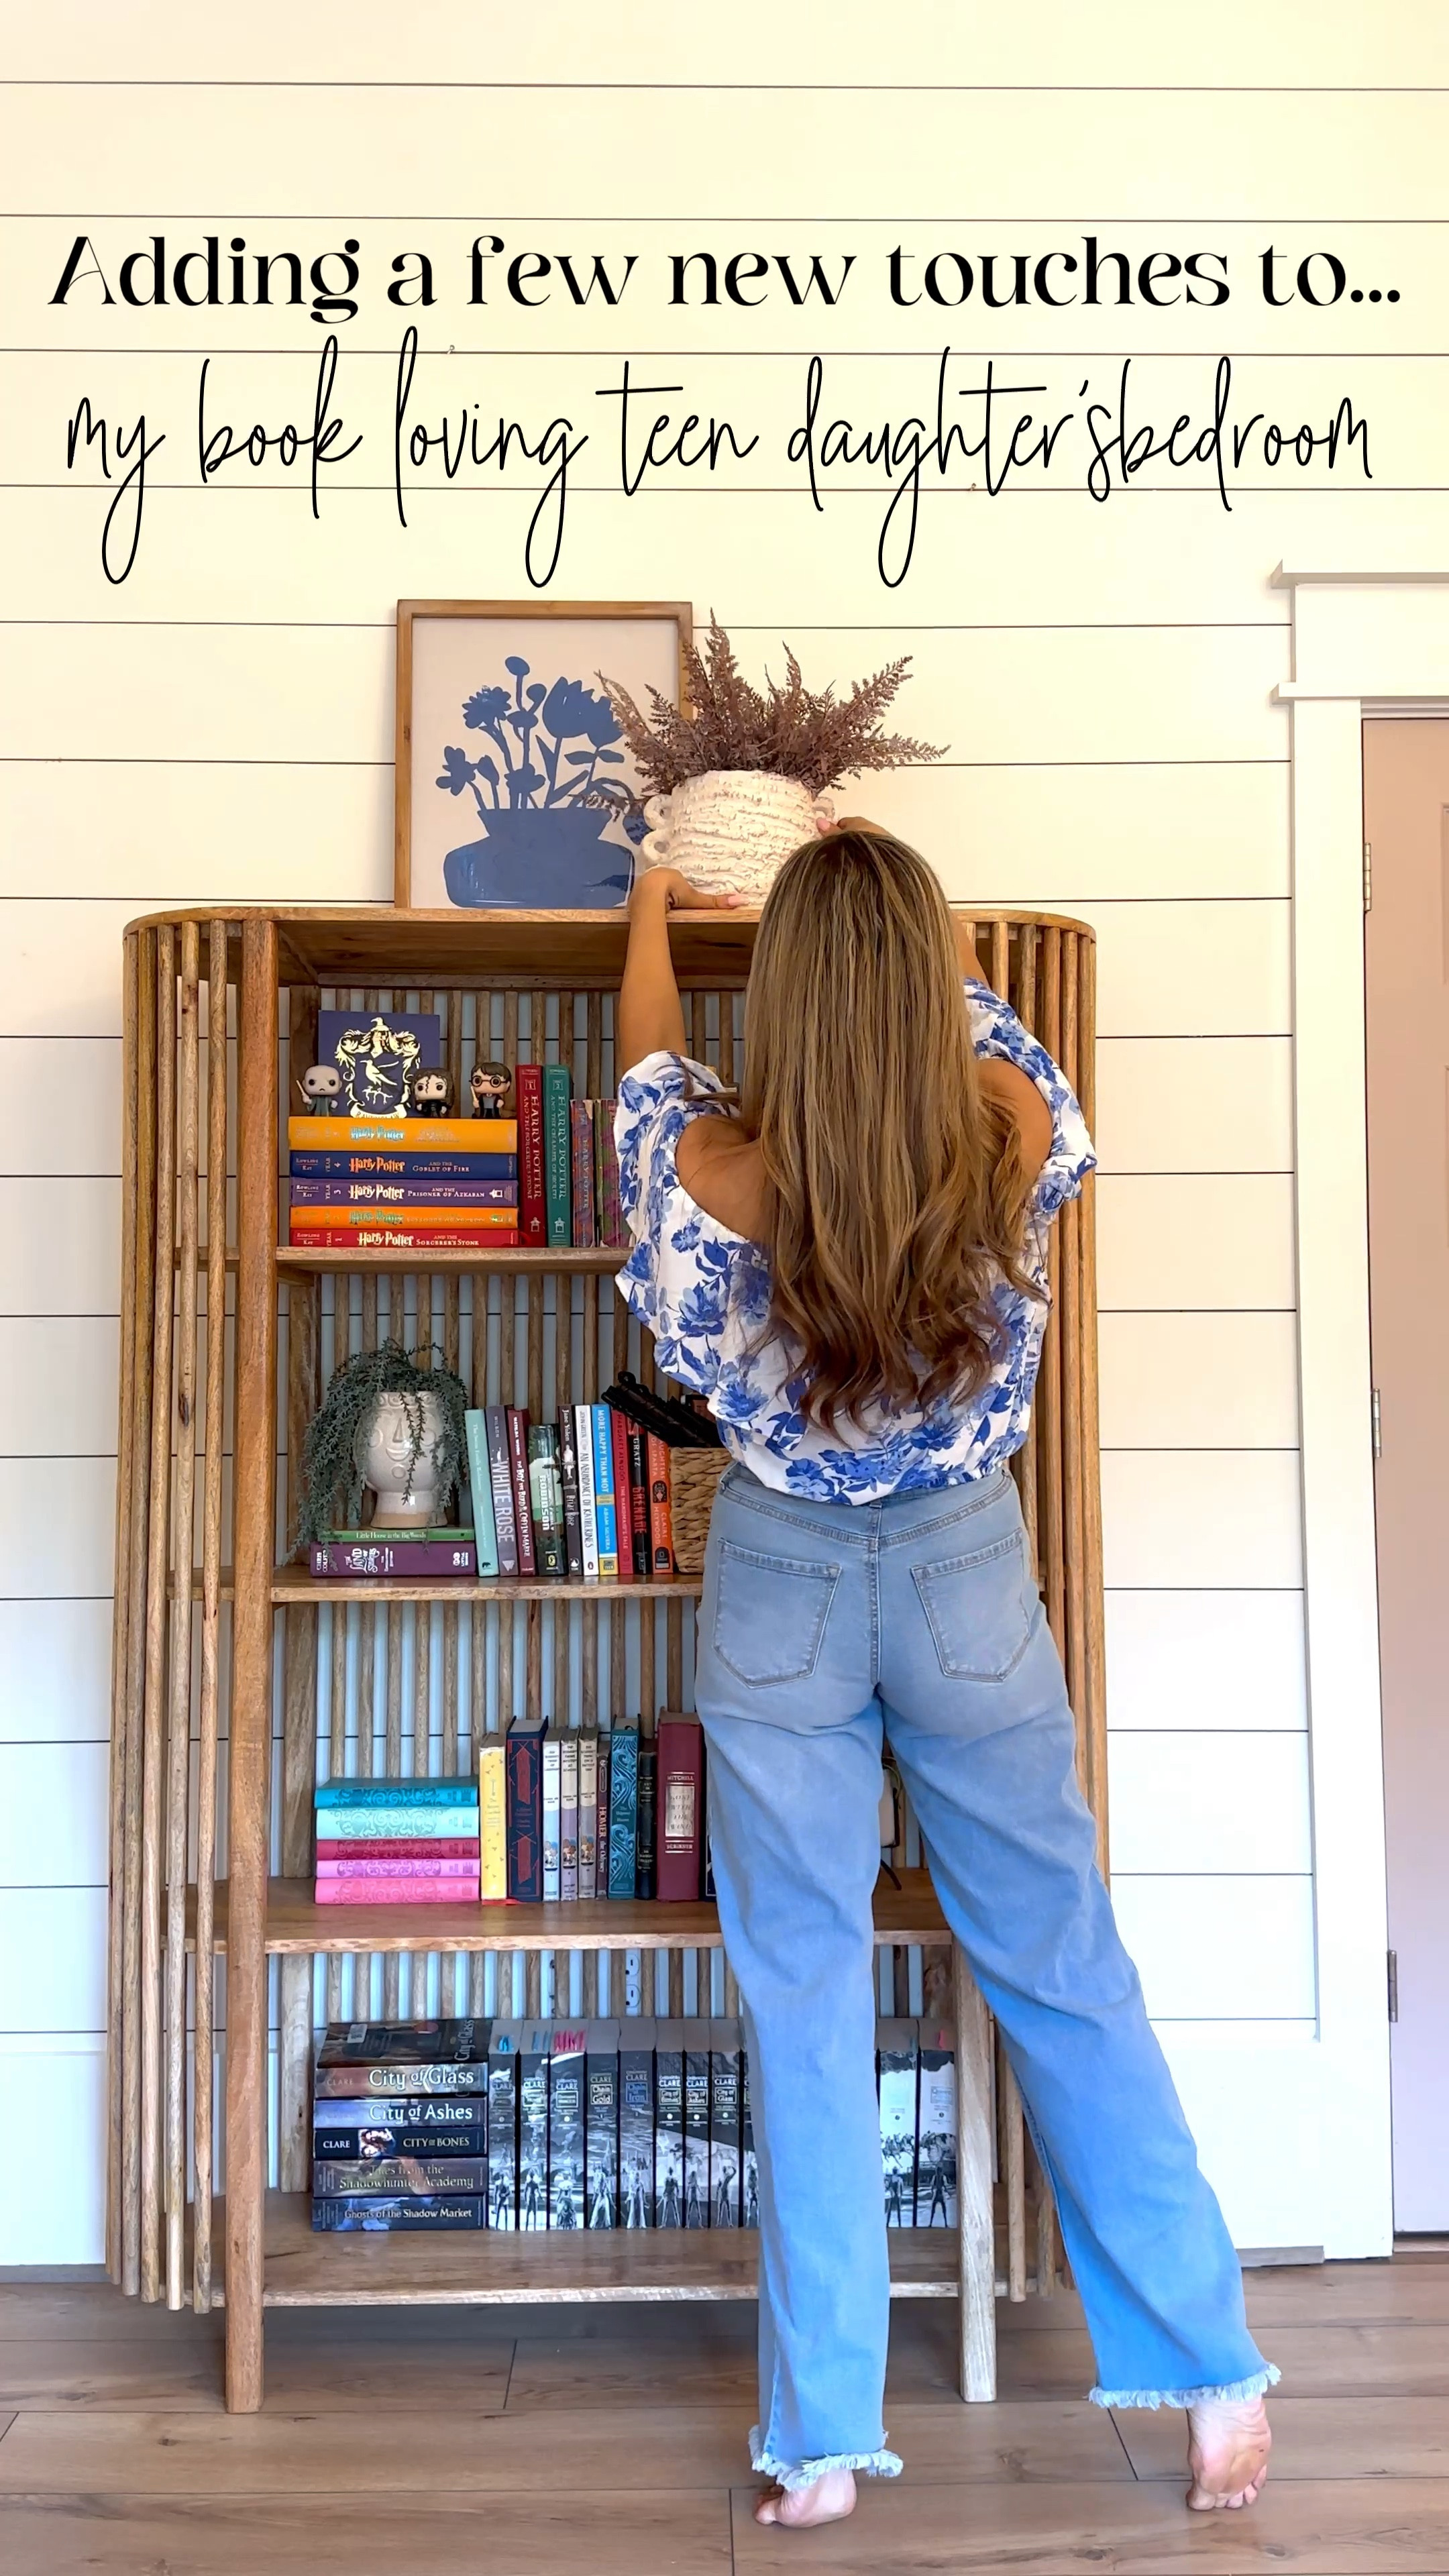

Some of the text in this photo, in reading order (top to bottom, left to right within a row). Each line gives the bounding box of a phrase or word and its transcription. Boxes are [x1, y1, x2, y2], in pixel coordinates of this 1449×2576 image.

[531, 1095, 542, 1199] HARRY POTTER
[557, 1095, 568, 1200] HARRY POTTER
[349, 1157, 405, 1174] Harry Potter
[551, 1163, 557, 1173] OF
[348, 1184, 405, 1201] Harry Potter
[357, 1231, 414, 1247] Harry Potter
[598, 1409, 606, 1430] MORE
[598, 1432, 607, 1455] HAPPY
[633, 1438, 641, 1467] GRATZ
[516, 1468, 525, 1483] BOY
[600, 1457, 608, 1476] THAN
[600, 1478, 609, 1493] NOT
[492, 1460, 515, 1543] WHITE ROSE
[518, 1490, 527, 1506] BIRD
[539, 1475, 549, 1530] ROBINSON
[580, 1452, 594, 1548] AN ABUNDANCE OF KATHERINES
[565, 1495, 580, 1526] Briar Rose
[632, 1487, 647, 1534] GRENADE
[350, 1548, 367, 1574] LAND
[598, 1806, 607, 1838] HOMER
[598, 1849, 607, 1873] Odyssey
[454, 2019, 476, 2061] City Glass
[327, 2078, 354, 2086] CLARE
[370, 2067, 474, 2090] City of Glass
[556, 2082, 578, 2090] CLARE
[592, 2094, 610, 2104] Gold
[370, 2103, 473, 2125] City of Ashes
[323, 2140, 350, 2149] CLARE
[403, 2137, 470, 2147] CITY BONES
[427, 2163, 444, 2174] the
[339, 2178, 418, 2190] Shadowhunter
[425, 2176, 474, 2189] Academy
[344, 2207, 472, 2218] Ghosts of the Shadow Market
